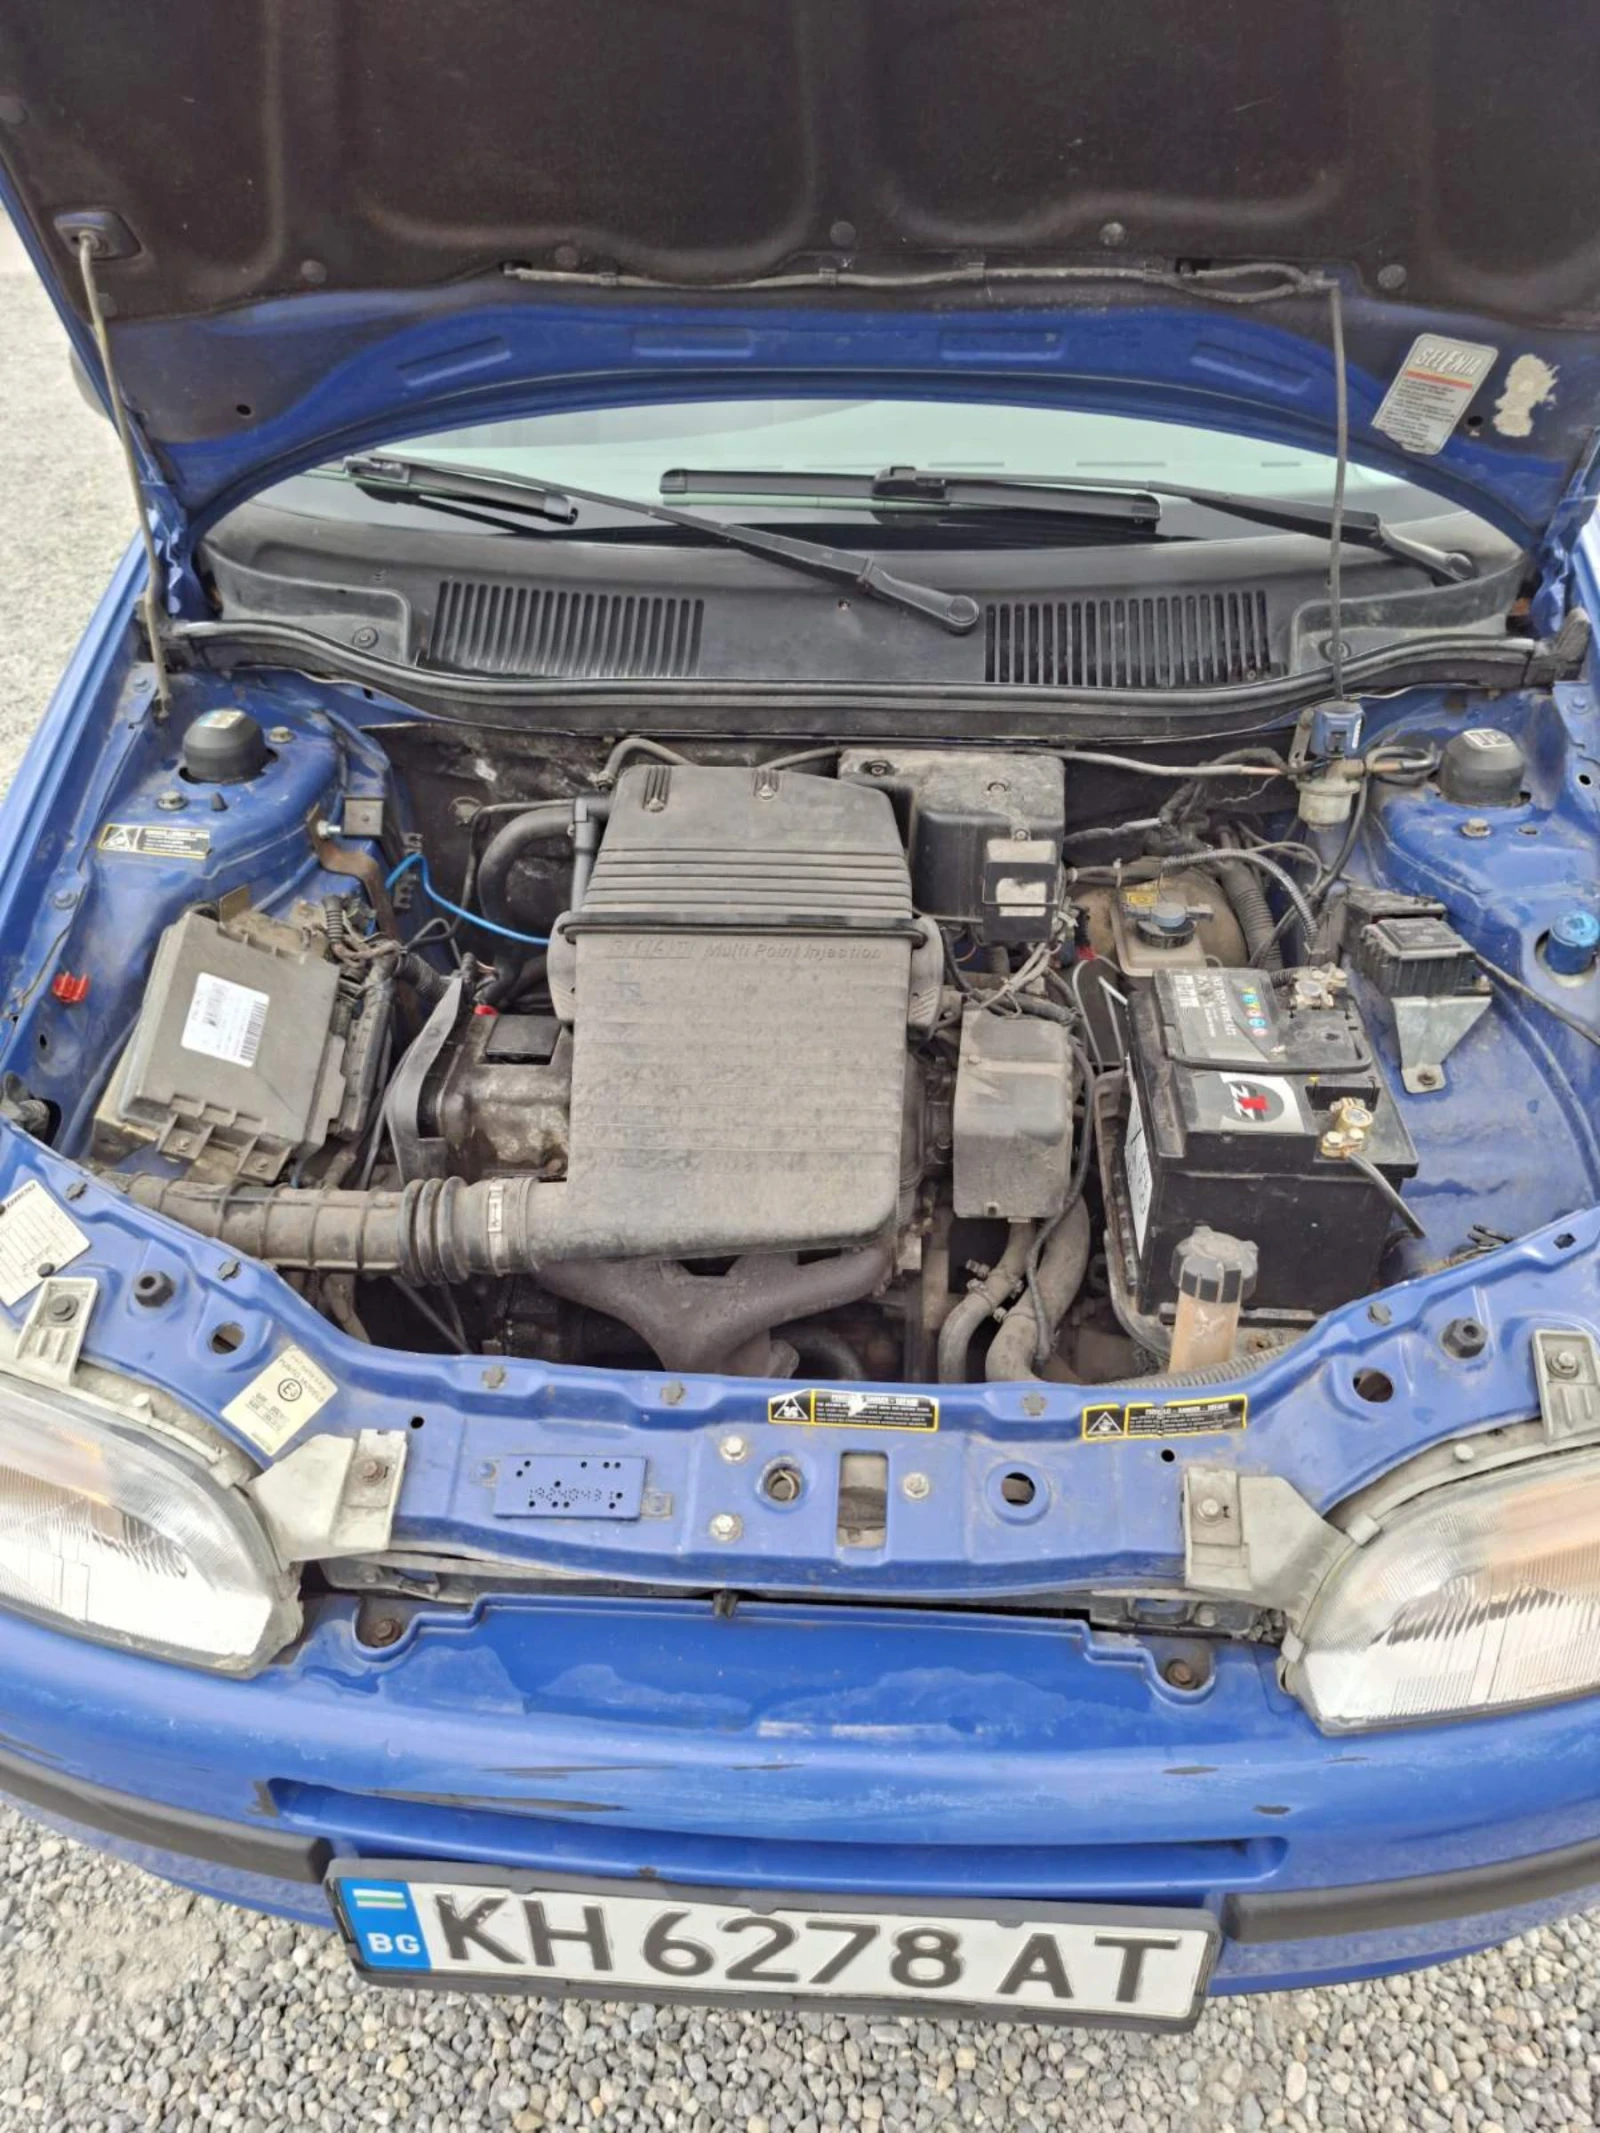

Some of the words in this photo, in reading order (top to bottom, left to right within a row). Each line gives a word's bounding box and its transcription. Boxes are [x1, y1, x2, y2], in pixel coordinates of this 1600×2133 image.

[704, 943, 750, 958] Multi
[754, 945, 799, 959] Point
[367, 1933, 420, 1953] BG
[434, 1893, 614, 1971] KH
[642, 1911, 962, 1988] 6278
[997, 1933, 1180, 2003] AT
